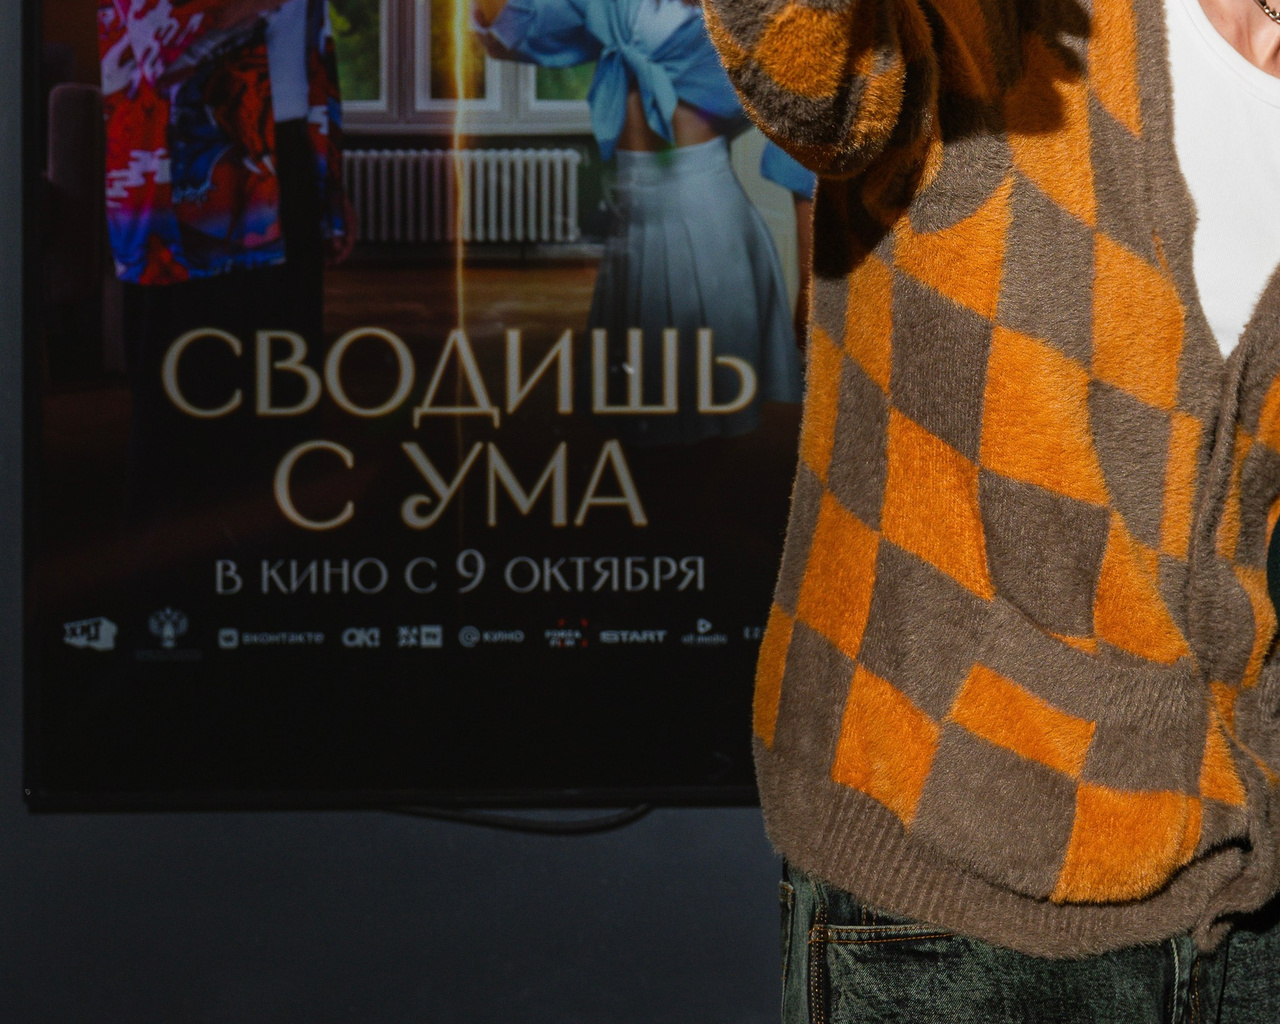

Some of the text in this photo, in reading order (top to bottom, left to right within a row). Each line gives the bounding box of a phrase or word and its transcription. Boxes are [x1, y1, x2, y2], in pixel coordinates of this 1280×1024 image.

[163, 327, 758, 429] СВОДИШЬ
[273, 439, 648, 531] С УМА
[215, 549, 705, 594] В КИНО С 9 ОКТЯБРЯ
[599, 629, 668, 643] START
